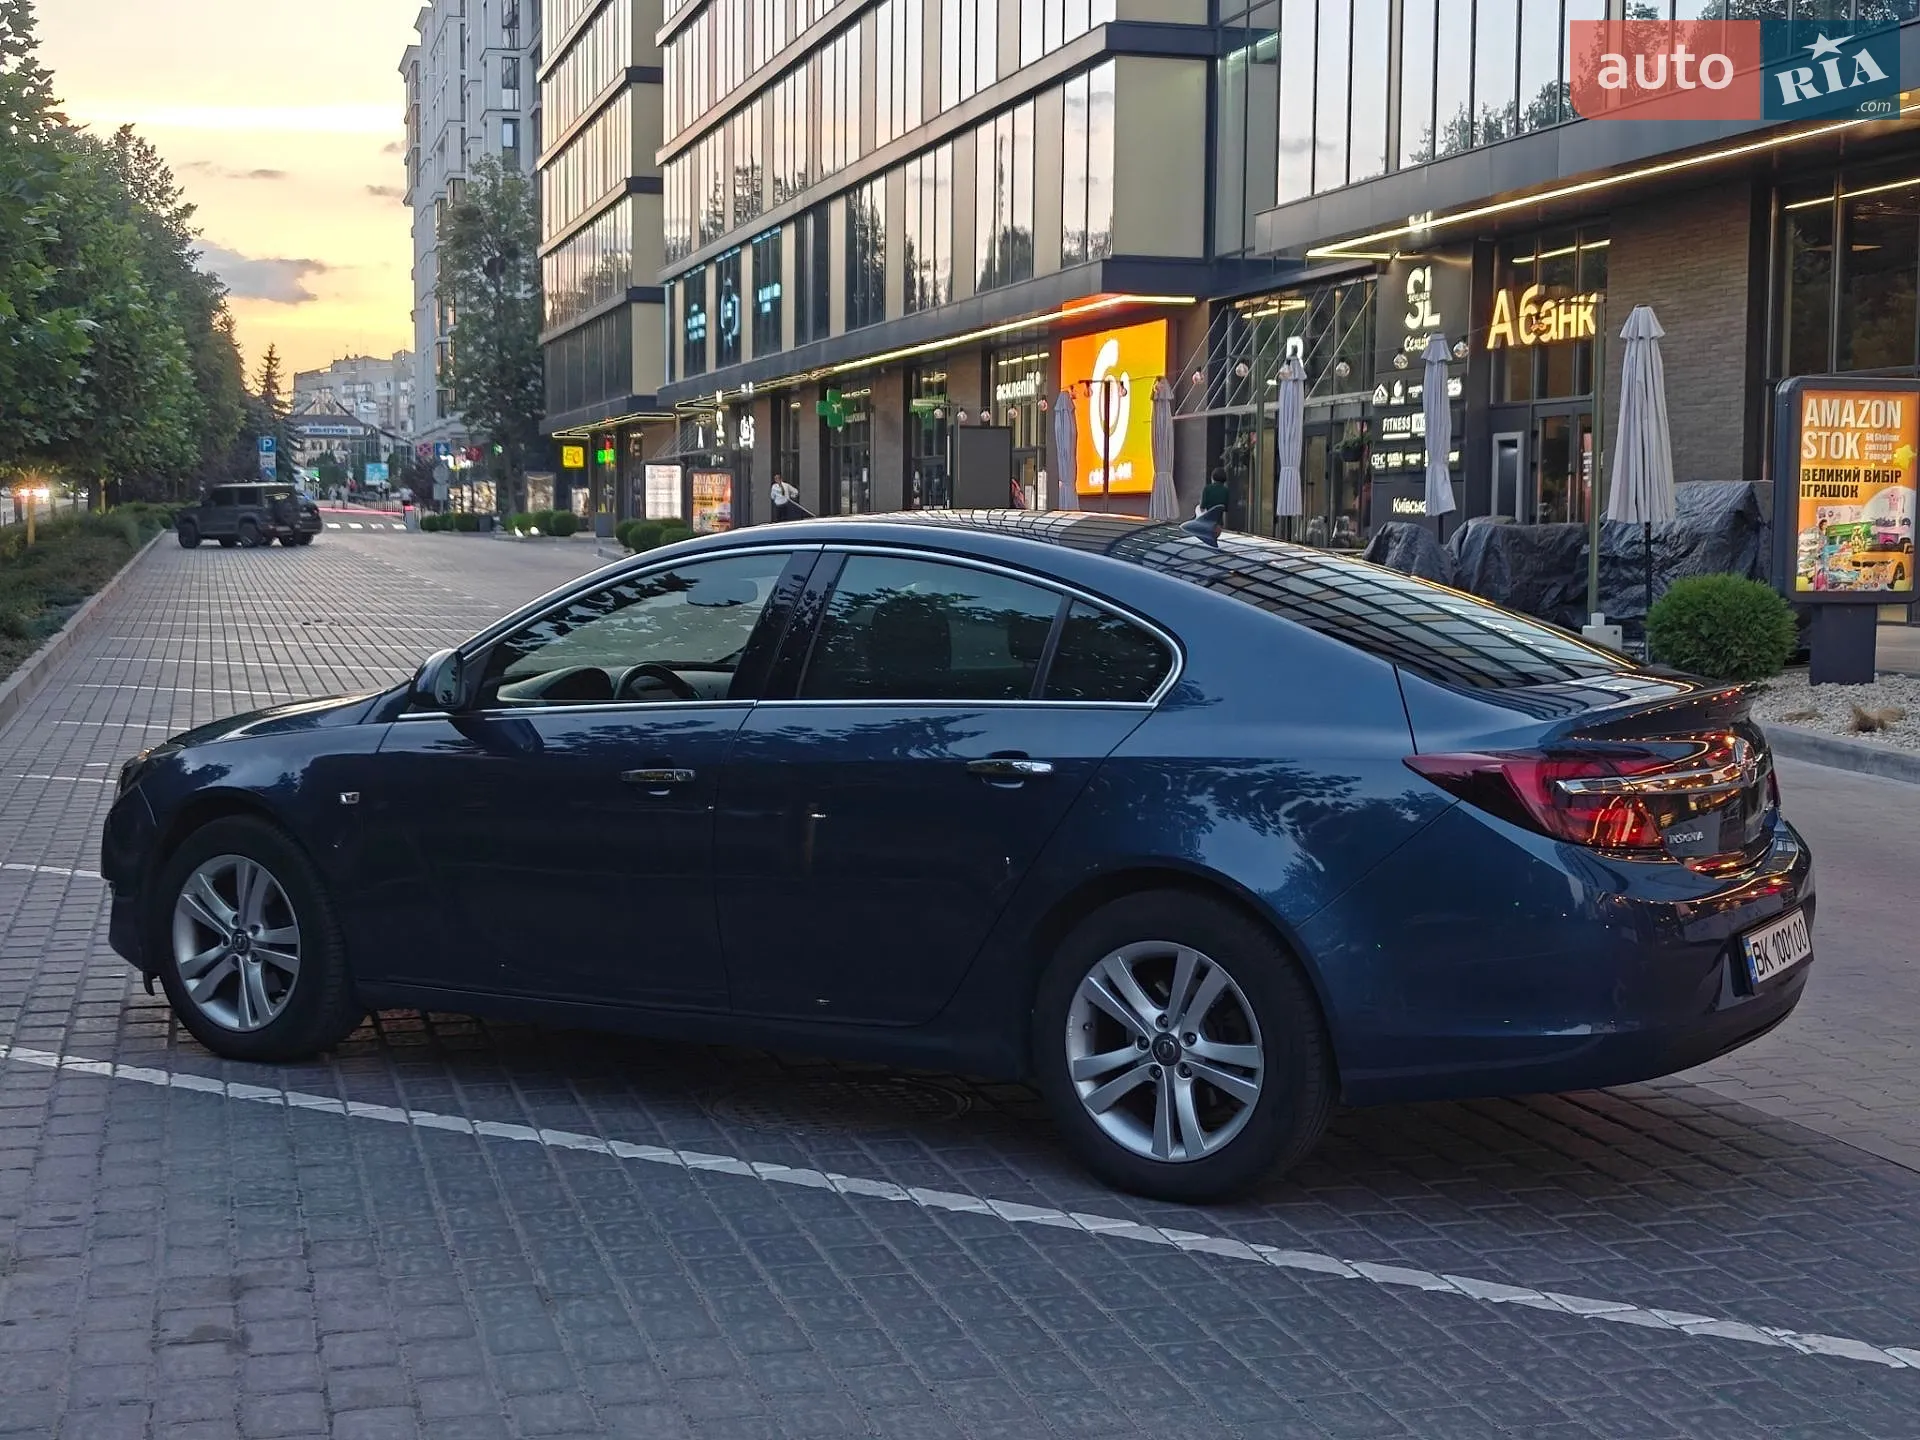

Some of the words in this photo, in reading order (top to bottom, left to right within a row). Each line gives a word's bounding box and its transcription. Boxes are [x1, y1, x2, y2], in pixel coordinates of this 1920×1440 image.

[1803, 398, 1902, 429] AMAZON
[1382, 415, 1411, 433] FITNESS
[263, 438, 272, 451] P
[1801, 430, 1862, 460] STOK
[1801, 467, 1861, 483] ВЕЛИКИЙ
[1863, 469, 1902, 484] ВИБІР
[1801, 484, 1858, 498] ІГРАШОК
[1752, 936, 1774, 976] BK
[1772, 925, 1796, 965] 1001
